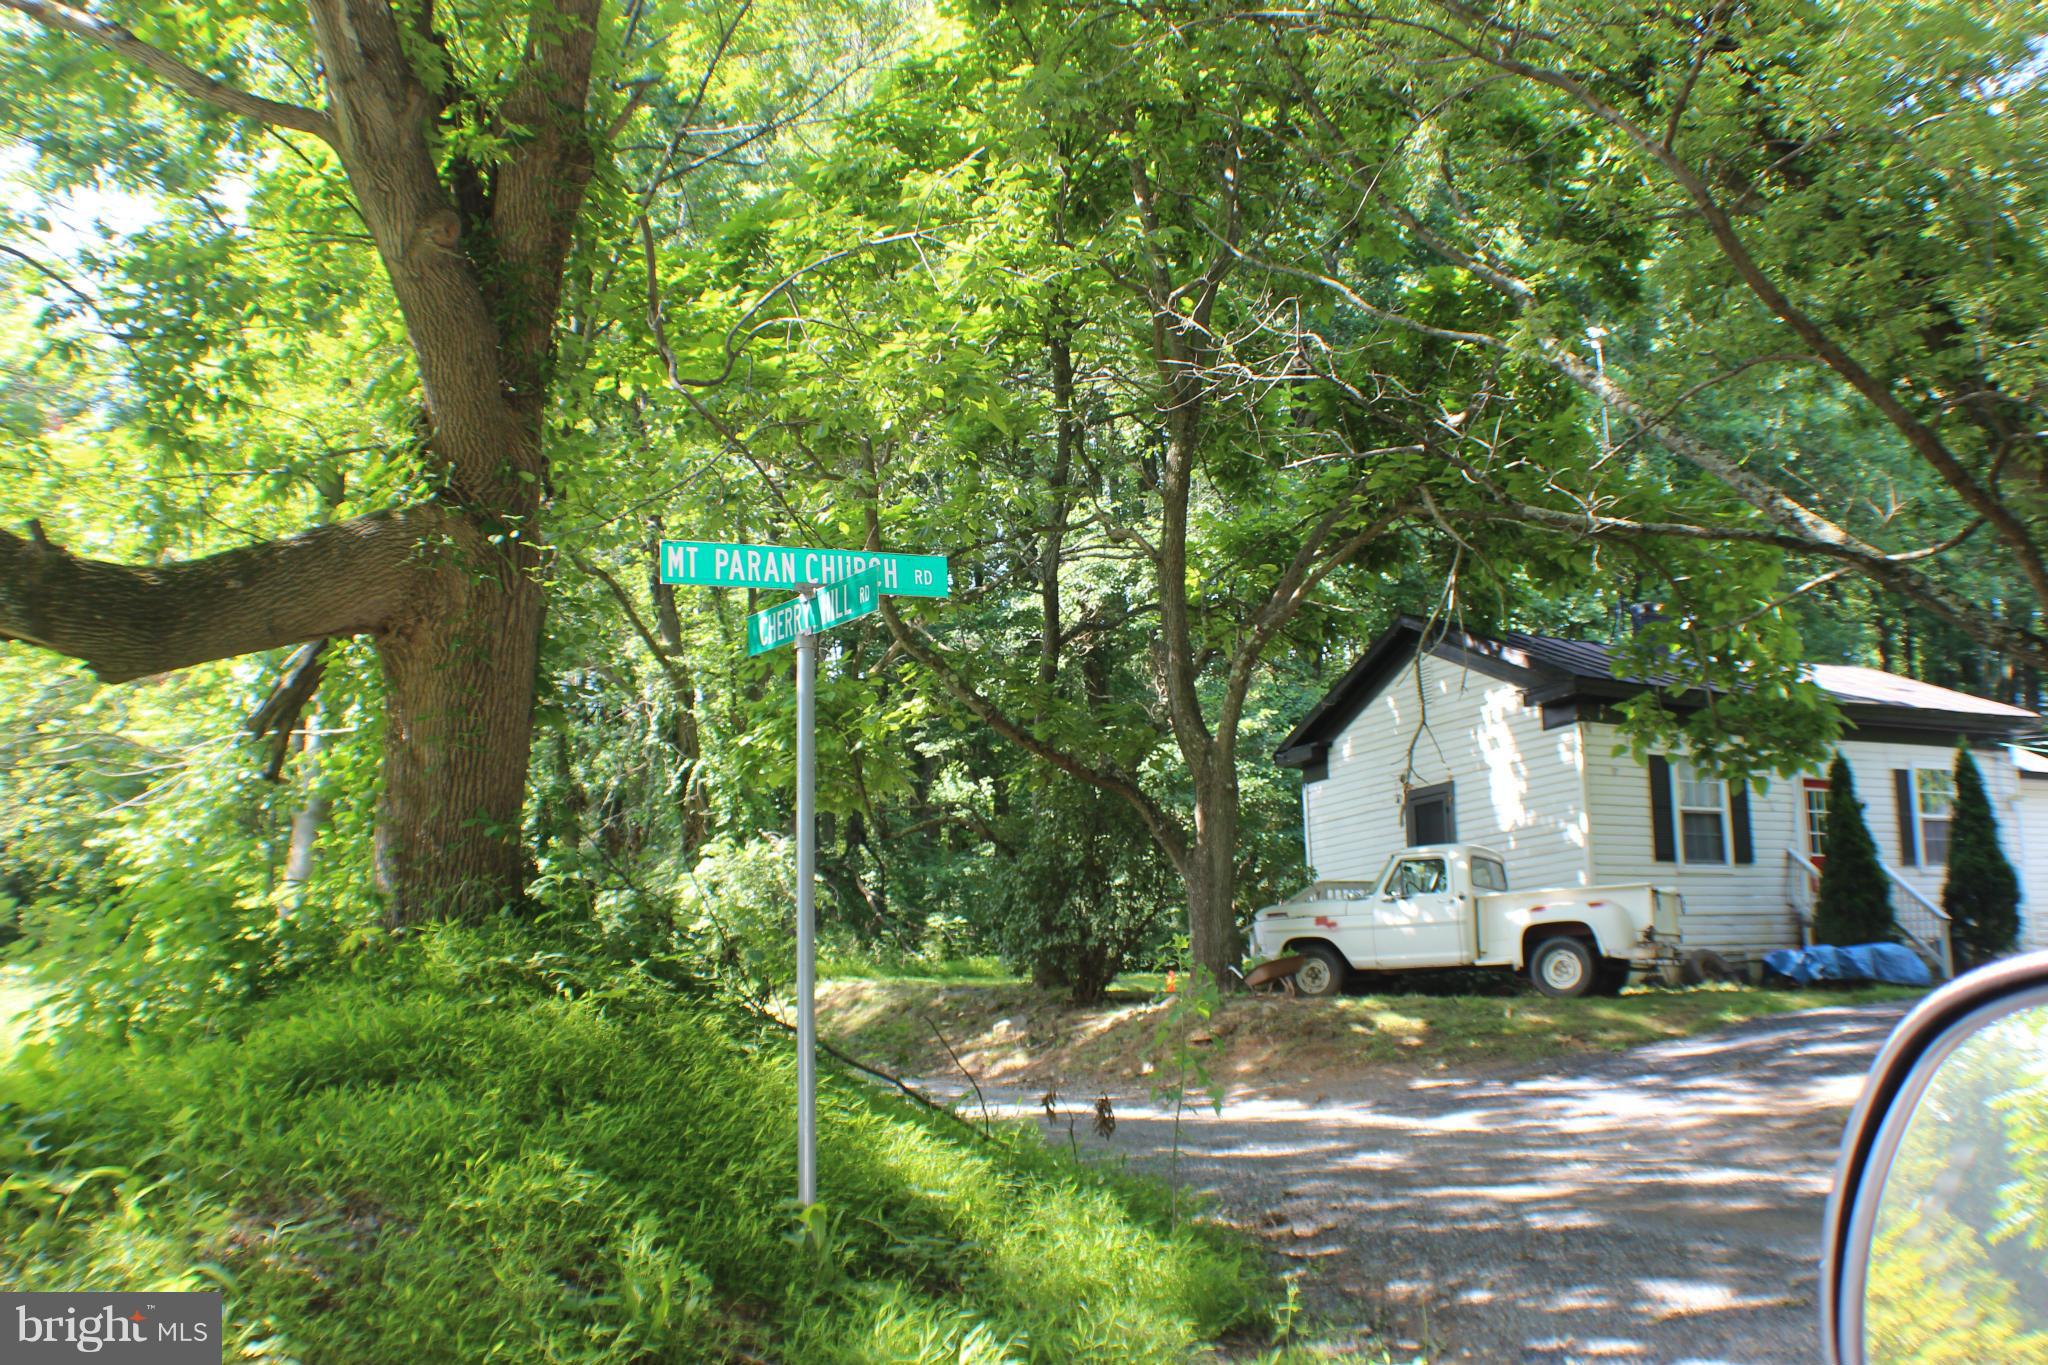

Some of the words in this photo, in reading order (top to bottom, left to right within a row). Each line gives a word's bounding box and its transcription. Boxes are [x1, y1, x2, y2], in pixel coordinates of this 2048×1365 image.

[667, 546, 698, 578] MT
[715, 548, 796, 583] PARAN
[914, 569, 933, 585] RD
[758, 599, 813, 647] CHERRY
[859, 584, 870, 604] RD
